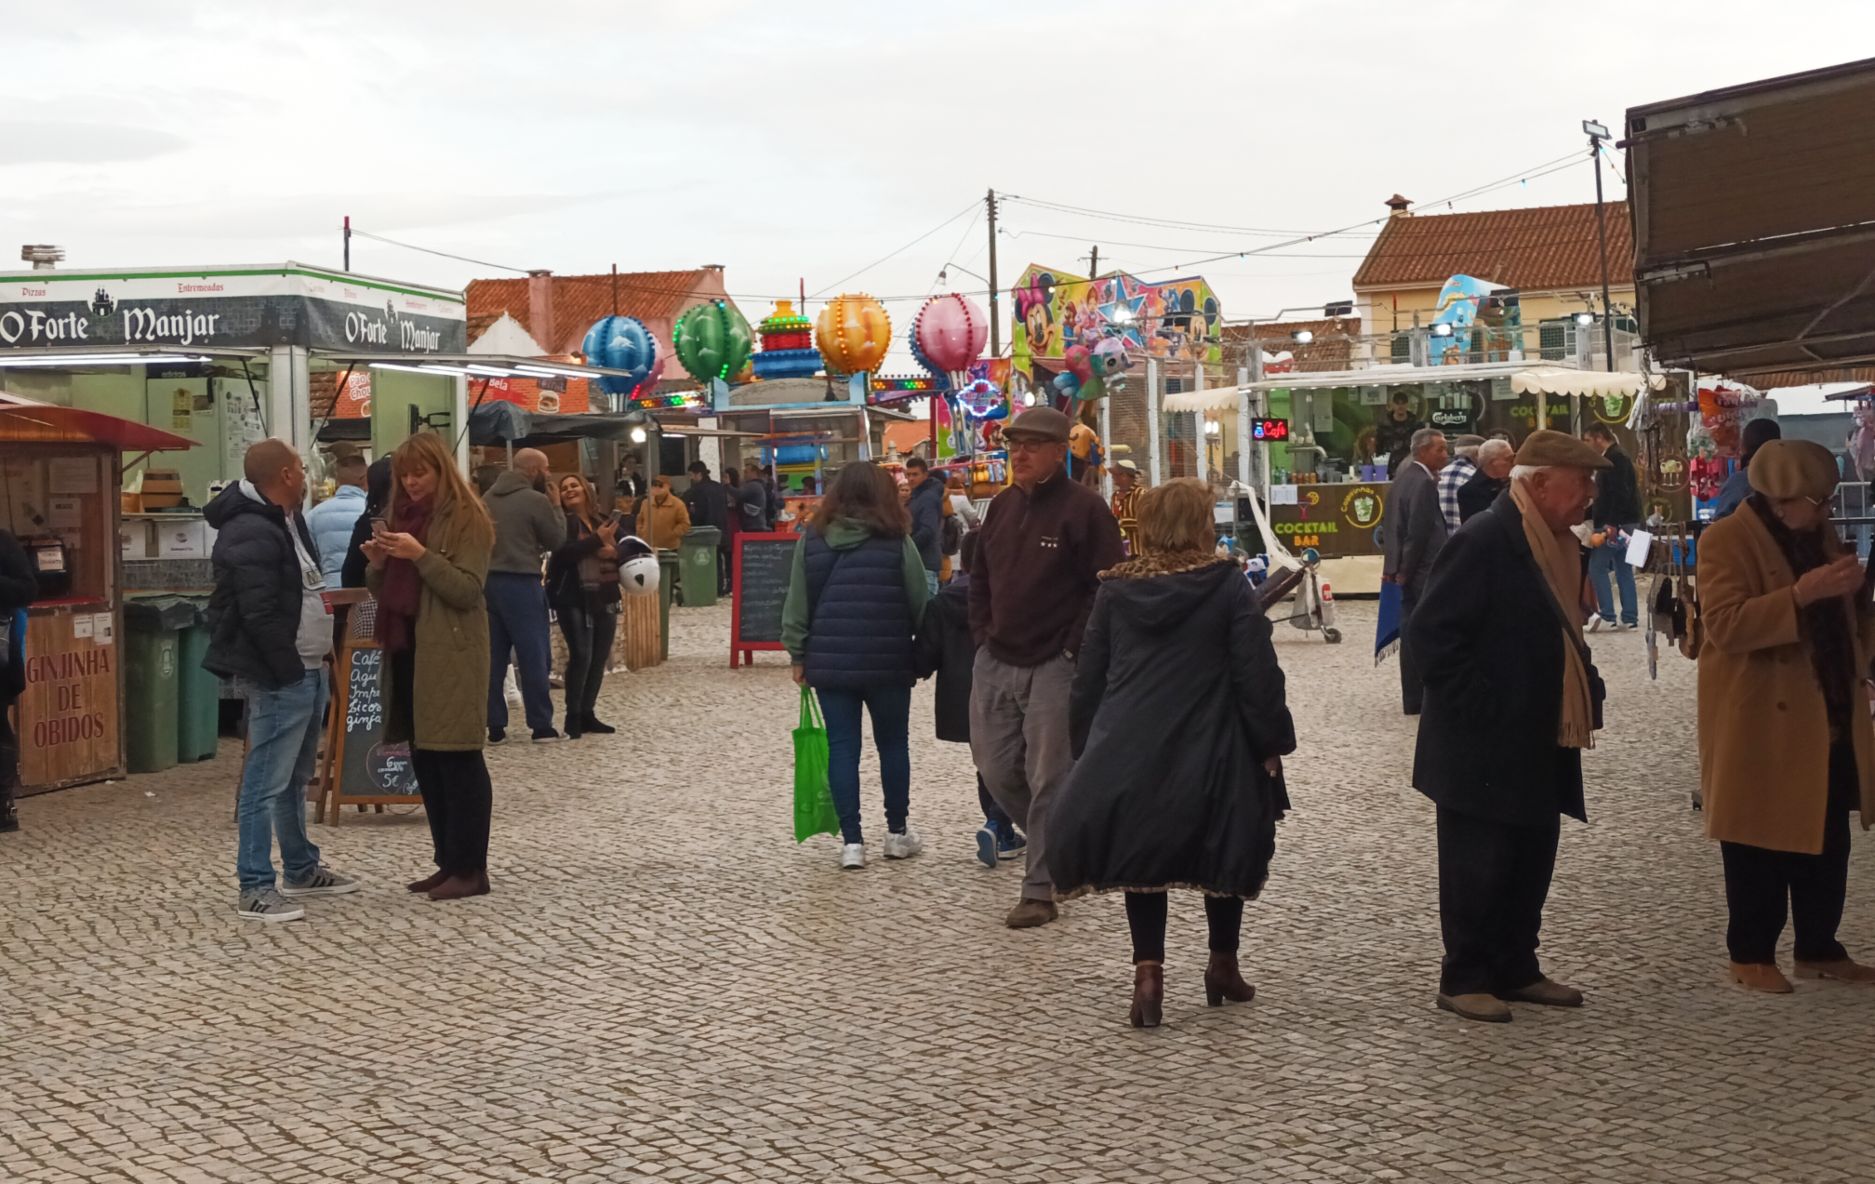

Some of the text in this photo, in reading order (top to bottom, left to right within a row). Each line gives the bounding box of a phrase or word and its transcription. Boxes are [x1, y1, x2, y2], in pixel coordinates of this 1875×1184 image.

[22, 287, 46, 297] Pizzas
[25, 309, 88, 342] Forte
[123, 307, 220, 346] Manjar
[345, 312, 440, 354] O Forte Manjar
[1510, 405, 1569, 417] COCTAIL
[1274, 522, 1338, 534] COCKTAIL
[1293, 535, 1319, 546] BAR
[26, 648, 110, 683] GINJINHA
[352, 650, 383, 672] Café
[57, 683, 82, 712] DE
[33, 711, 104, 748] ÓBIDOS
